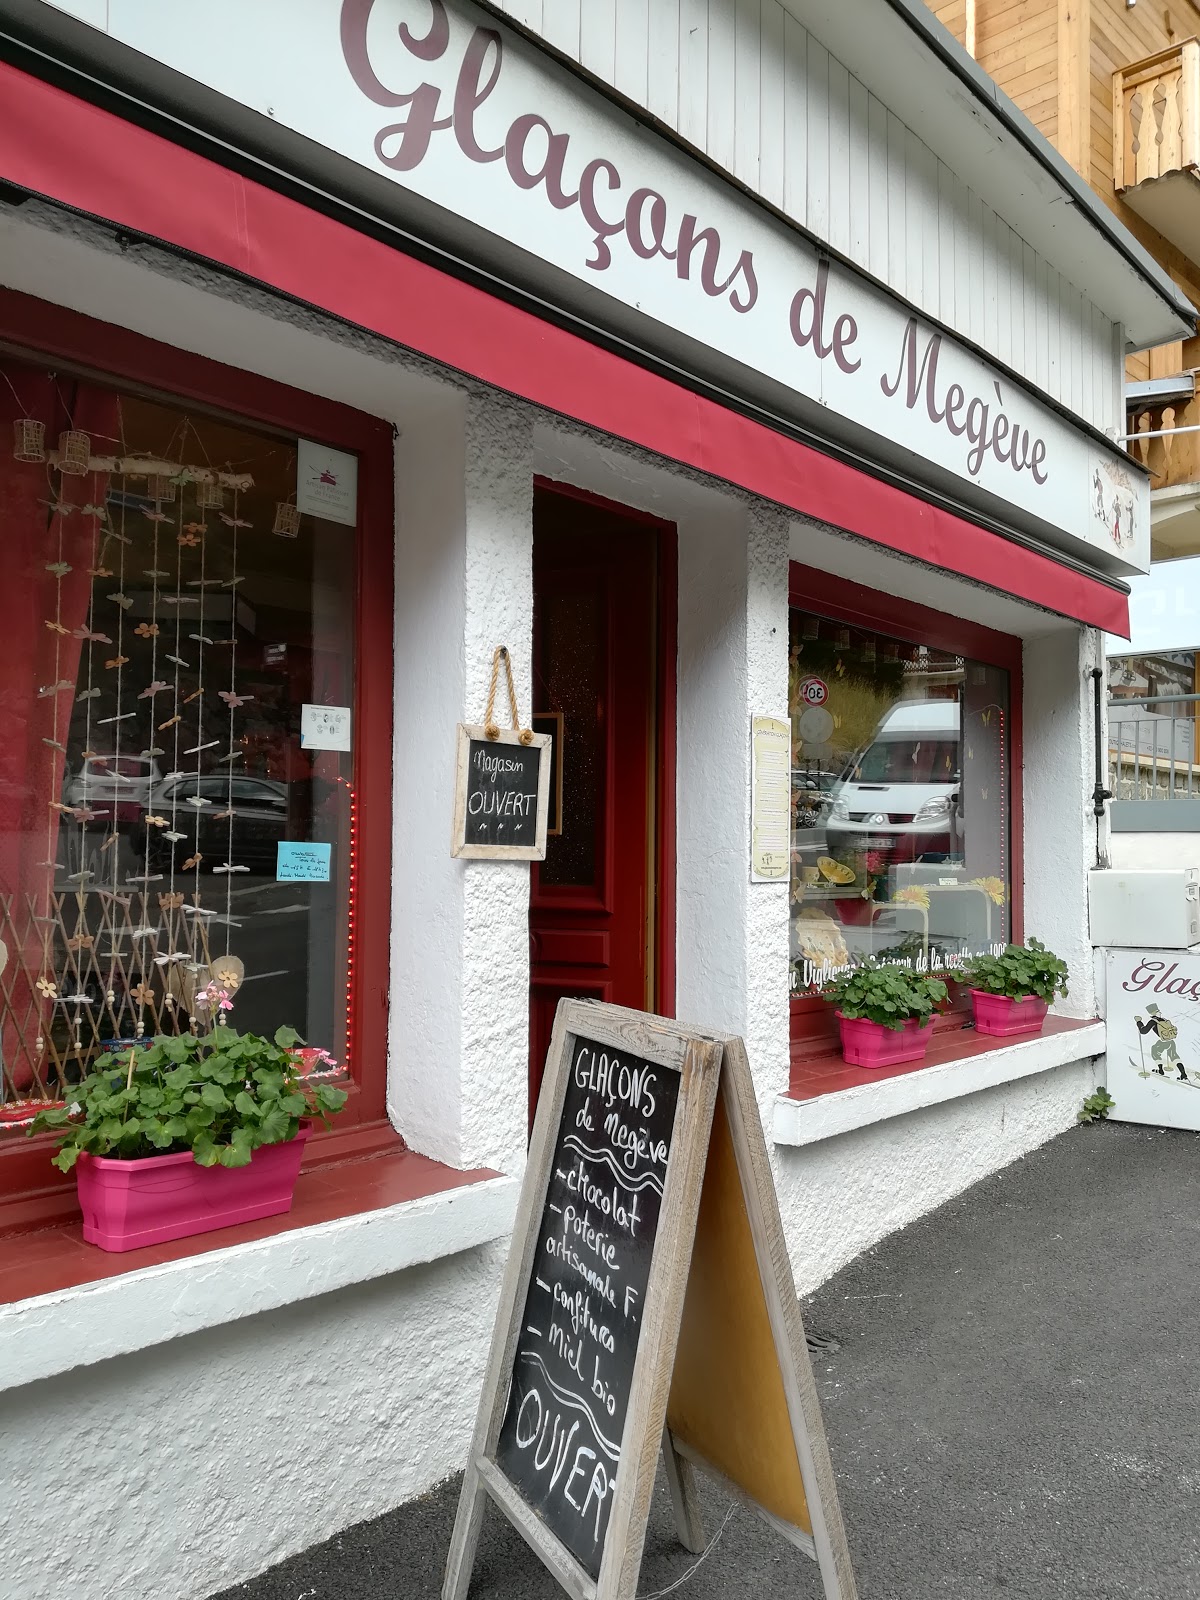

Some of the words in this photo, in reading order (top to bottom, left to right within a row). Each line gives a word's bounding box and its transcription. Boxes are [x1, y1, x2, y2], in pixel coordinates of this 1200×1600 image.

[340, 0, 758, 313] Glaçons
[790, 260, 861, 374] de
[880, 318, 1048, 484] Megève
[473, 749, 524, 782] Magasin
[468, 790, 536, 816] OUVERT
[916, 948, 928, 973] de
[931, 947, 944, 971] la
[574, 1047, 657, 1118] GLAÇONS
[576, 1097, 595, 1131] de
[591, 1354, 616, 1417] bio
[515, 1388, 616, 1543] OUVER
